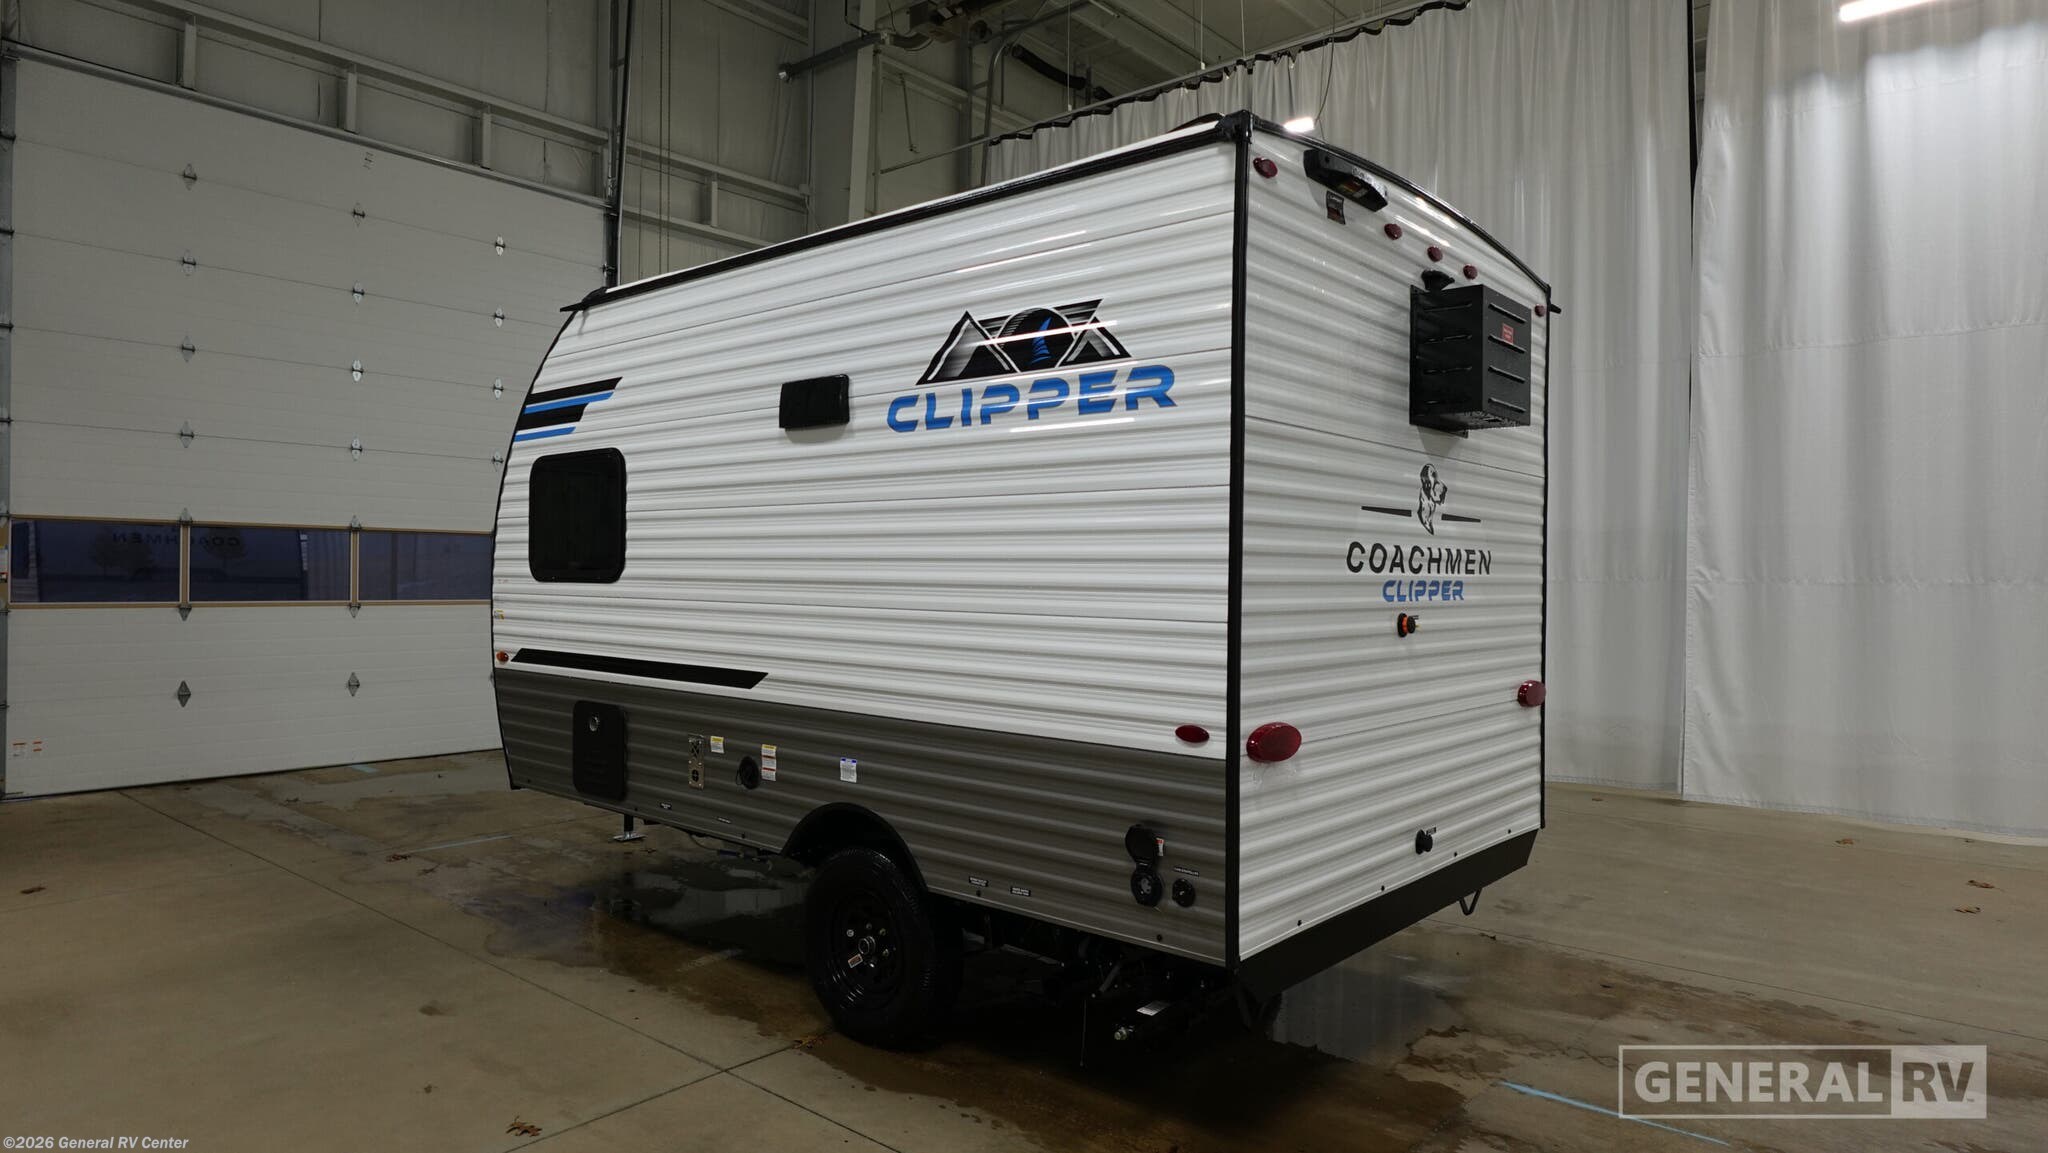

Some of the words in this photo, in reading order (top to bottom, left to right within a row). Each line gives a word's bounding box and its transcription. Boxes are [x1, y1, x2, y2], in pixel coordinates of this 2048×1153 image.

[887, 364, 1177, 433] CLIPPER
[1346, 541, 1492, 575] COACHMEN
[1382, 580, 1464, 602] CLIPPER
